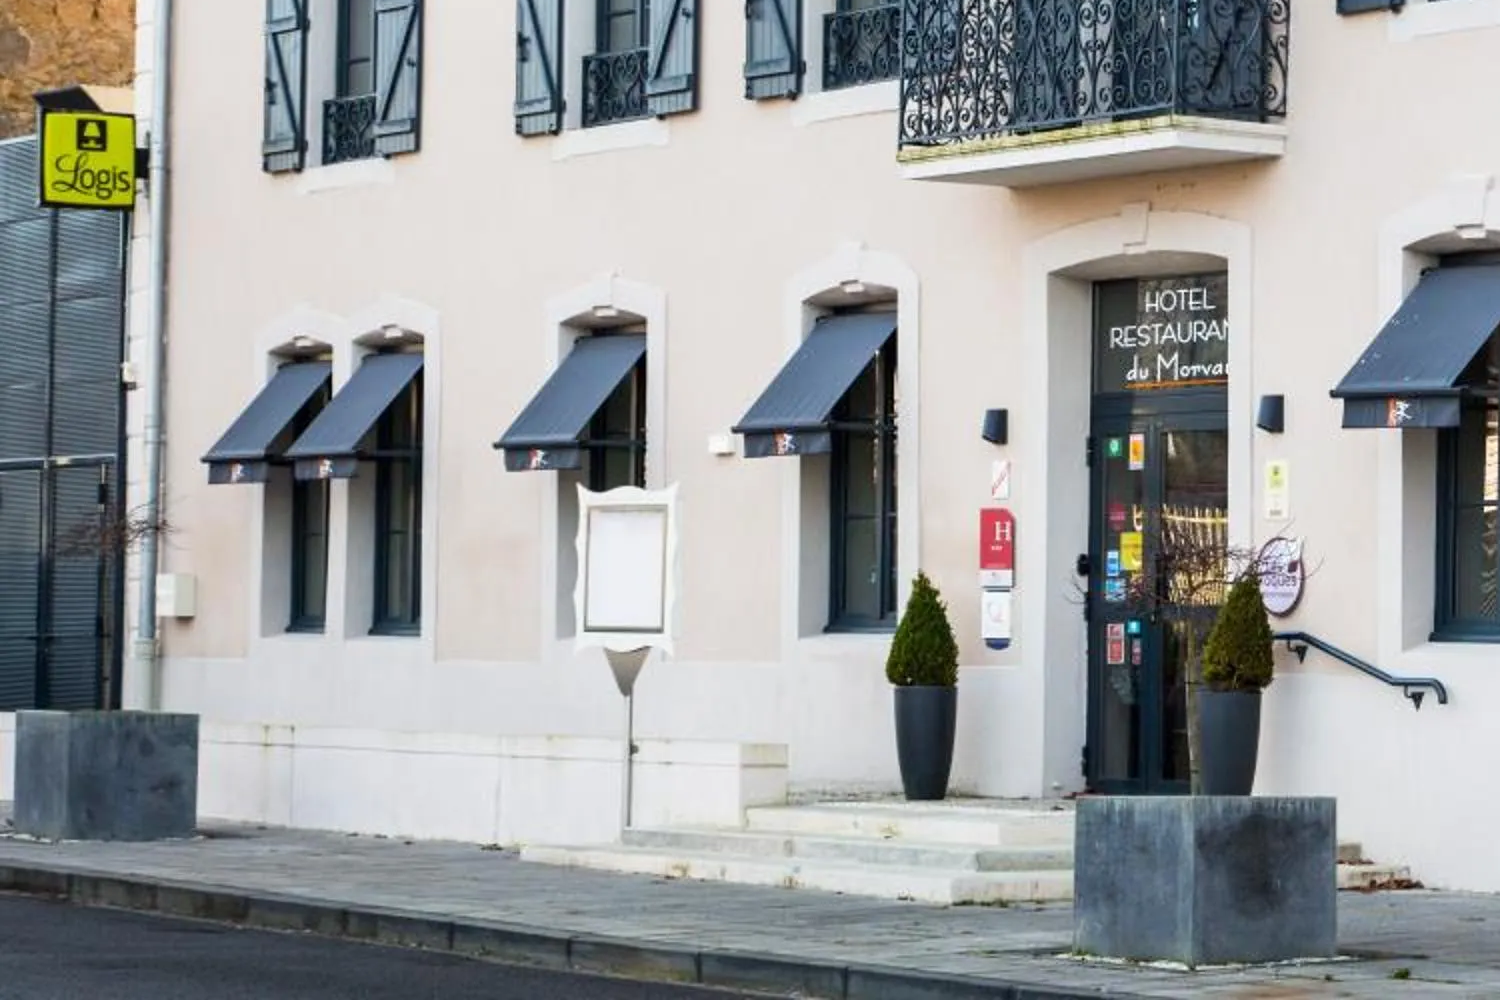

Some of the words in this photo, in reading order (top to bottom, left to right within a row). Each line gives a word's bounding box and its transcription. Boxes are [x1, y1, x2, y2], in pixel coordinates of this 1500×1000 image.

[51, 151, 131, 200] Logis
[1145, 287, 1217, 313] HOTEL
[1125, 353, 1150, 381] du
[994, 520, 1012, 542] H
